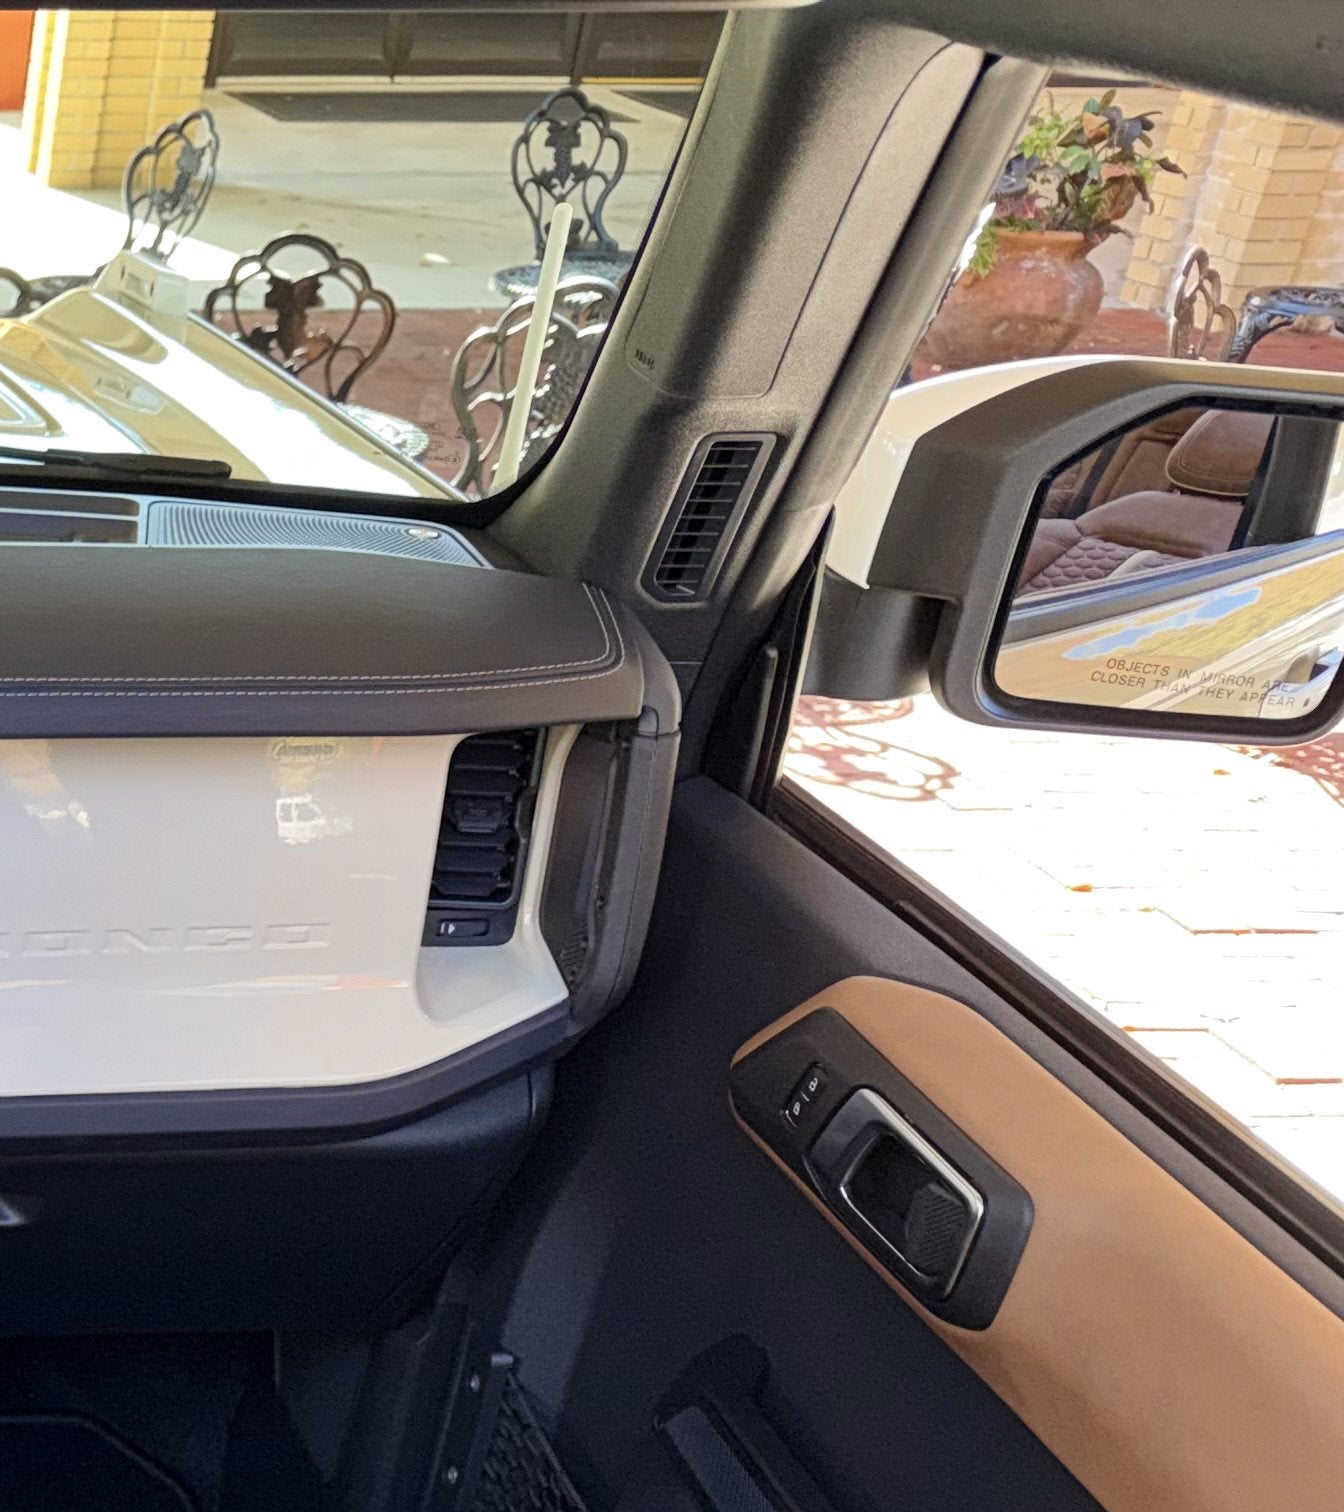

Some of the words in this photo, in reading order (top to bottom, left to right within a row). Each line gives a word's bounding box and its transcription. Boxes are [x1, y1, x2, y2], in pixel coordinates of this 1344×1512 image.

[1091, 670, 1146, 687] CLOSER
[1154, 679, 1191, 694] THAN
[1199, 685, 1234, 700] THEY
[1239, 691, 1296, 708] APPEAR
[1106, 658, 1171, 677] OBJECTS
[1178, 668, 1193, 679] IN
[1200, 671, 1257, 686] MIRROR
[1263, 679, 1289, 692] ARE
